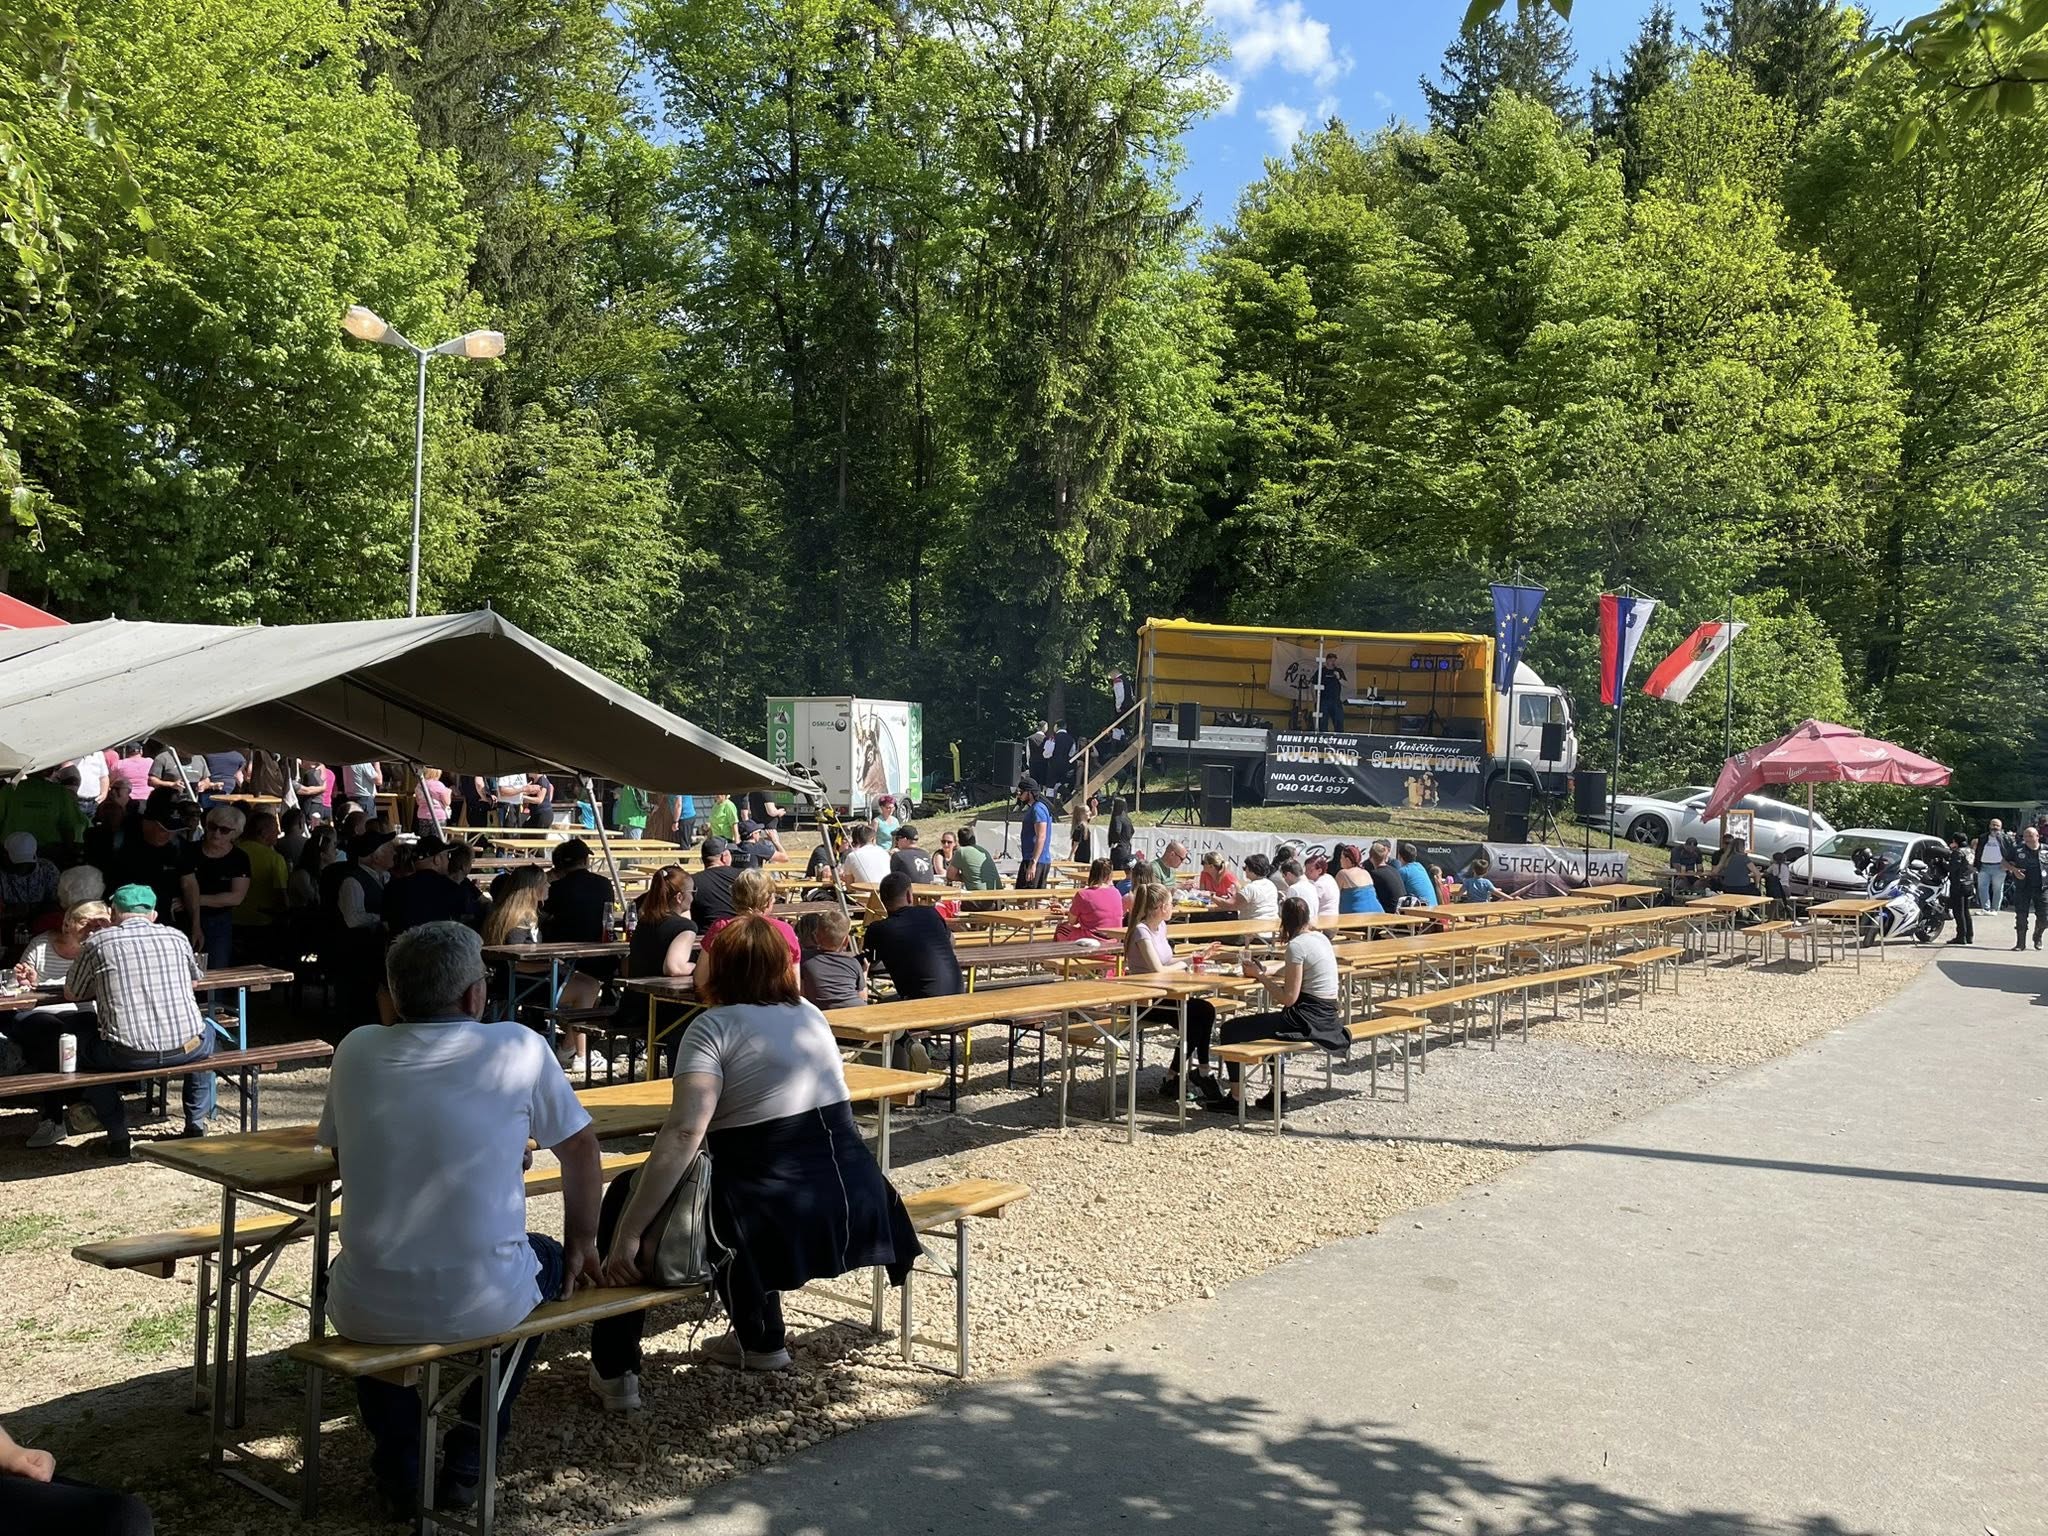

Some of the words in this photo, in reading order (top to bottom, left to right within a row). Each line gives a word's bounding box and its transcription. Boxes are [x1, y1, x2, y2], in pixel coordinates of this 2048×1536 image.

[1277, 735, 1302, 743] RAVNE
[1304, 736, 1317, 744] PRI
[1319, 736, 1357, 746] ŠOŠTANJU
[1389, 741, 1461, 754] Slaščičarna
[1277, 745, 1320, 764] NULA
[1324, 747, 1359, 767] BAR
[1371, 750, 1433, 771] SLADEK
[1434, 754, 1481, 774] DOTIK
[1270, 773, 1296, 781] NINA
[1298, 774, 1336, 783] OVČJAK
[1338, 777, 1356, 785] S.P.
[1786, 766, 1808, 780] Union
[1276, 783, 1299, 791] 040
[1300, 785, 1323, 793] 414
[1325, 786, 1349, 794] 997
[1156, 837, 1224, 850] OČINA
[1588, 861, 1624, 878] BAR
